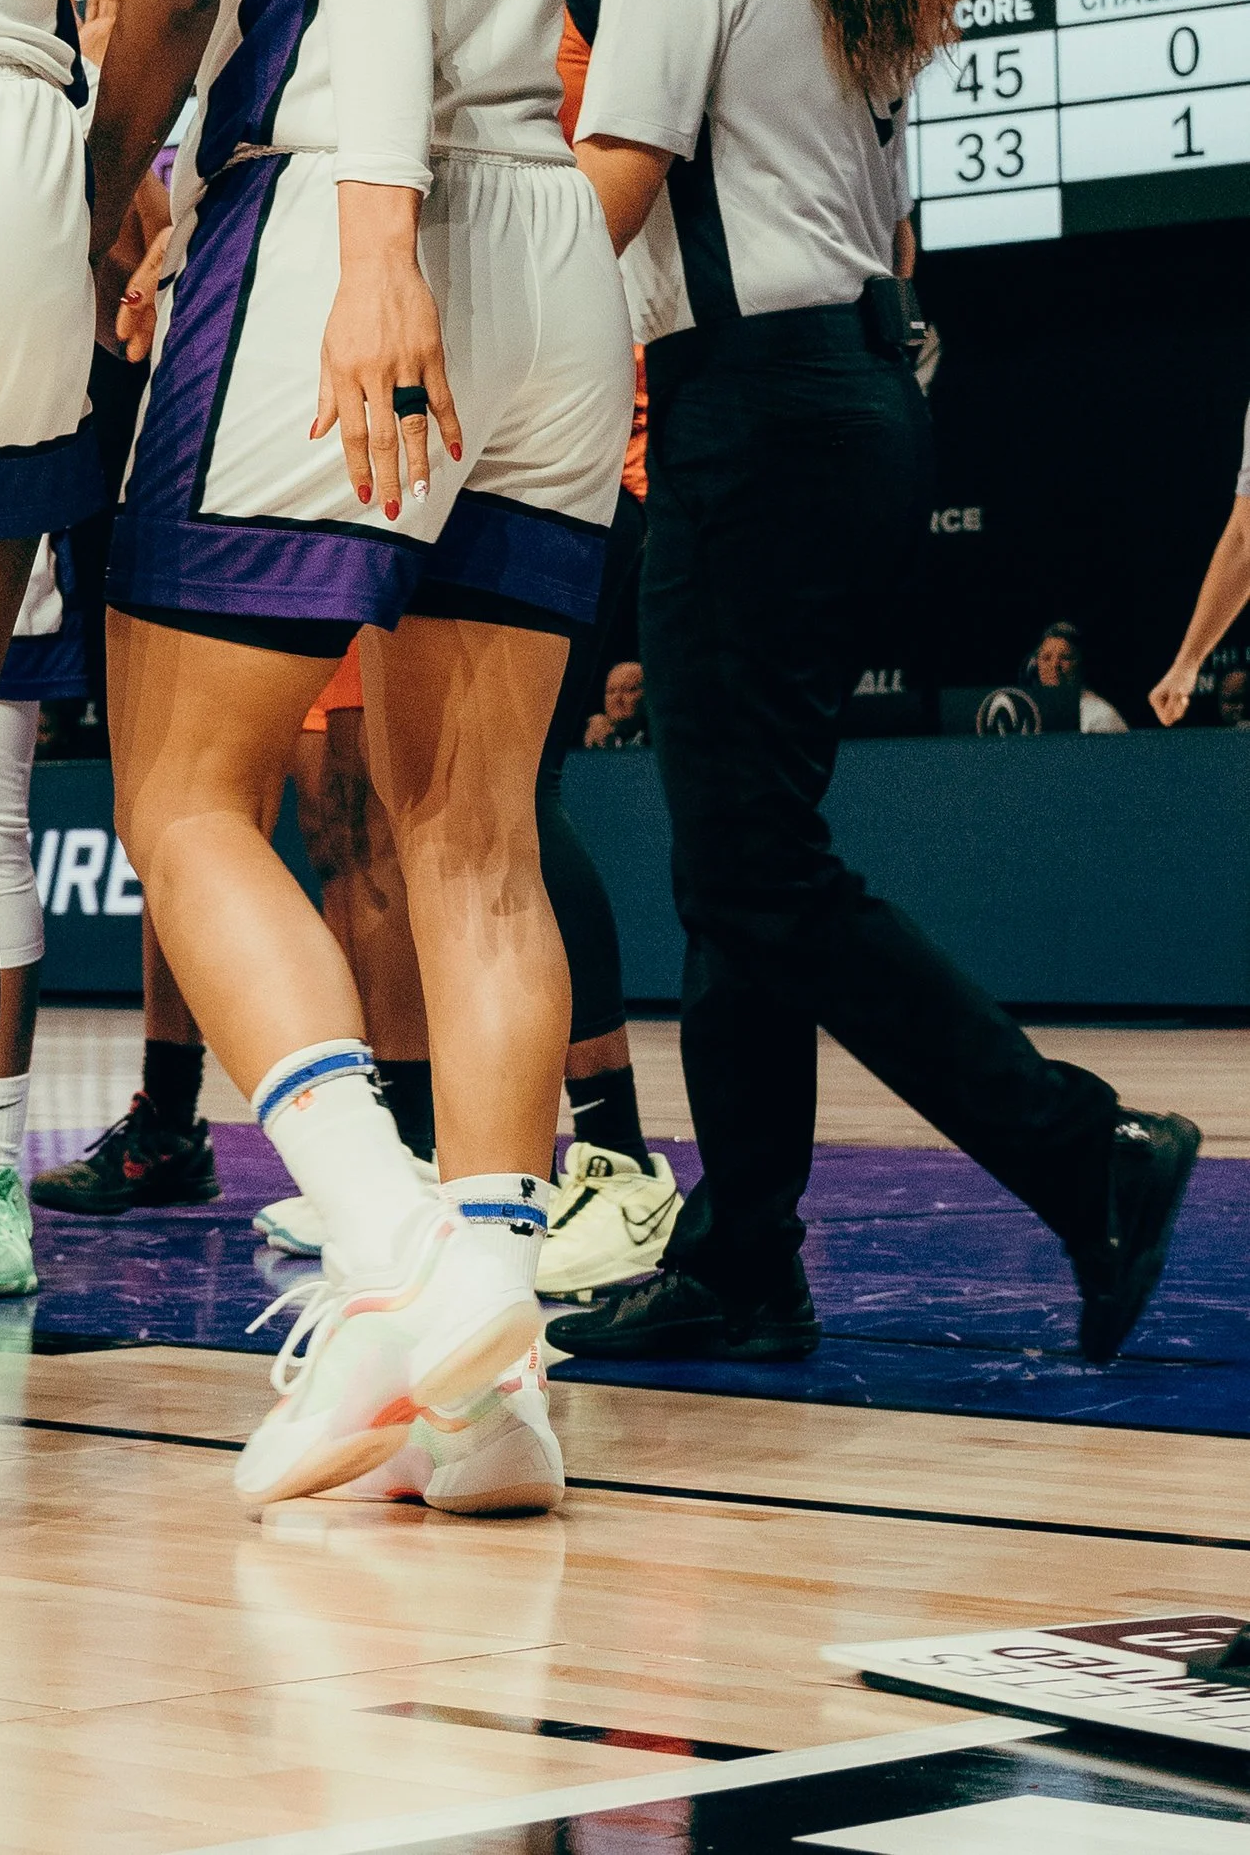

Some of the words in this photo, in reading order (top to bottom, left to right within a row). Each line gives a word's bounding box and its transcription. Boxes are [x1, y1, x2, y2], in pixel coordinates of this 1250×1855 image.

[954, 48, 1023, 103] 45
[1169, 26, 1201, 77] 0
[957, 128, 1025, 183] 33
[1172, 106, 1205, 159] 1
